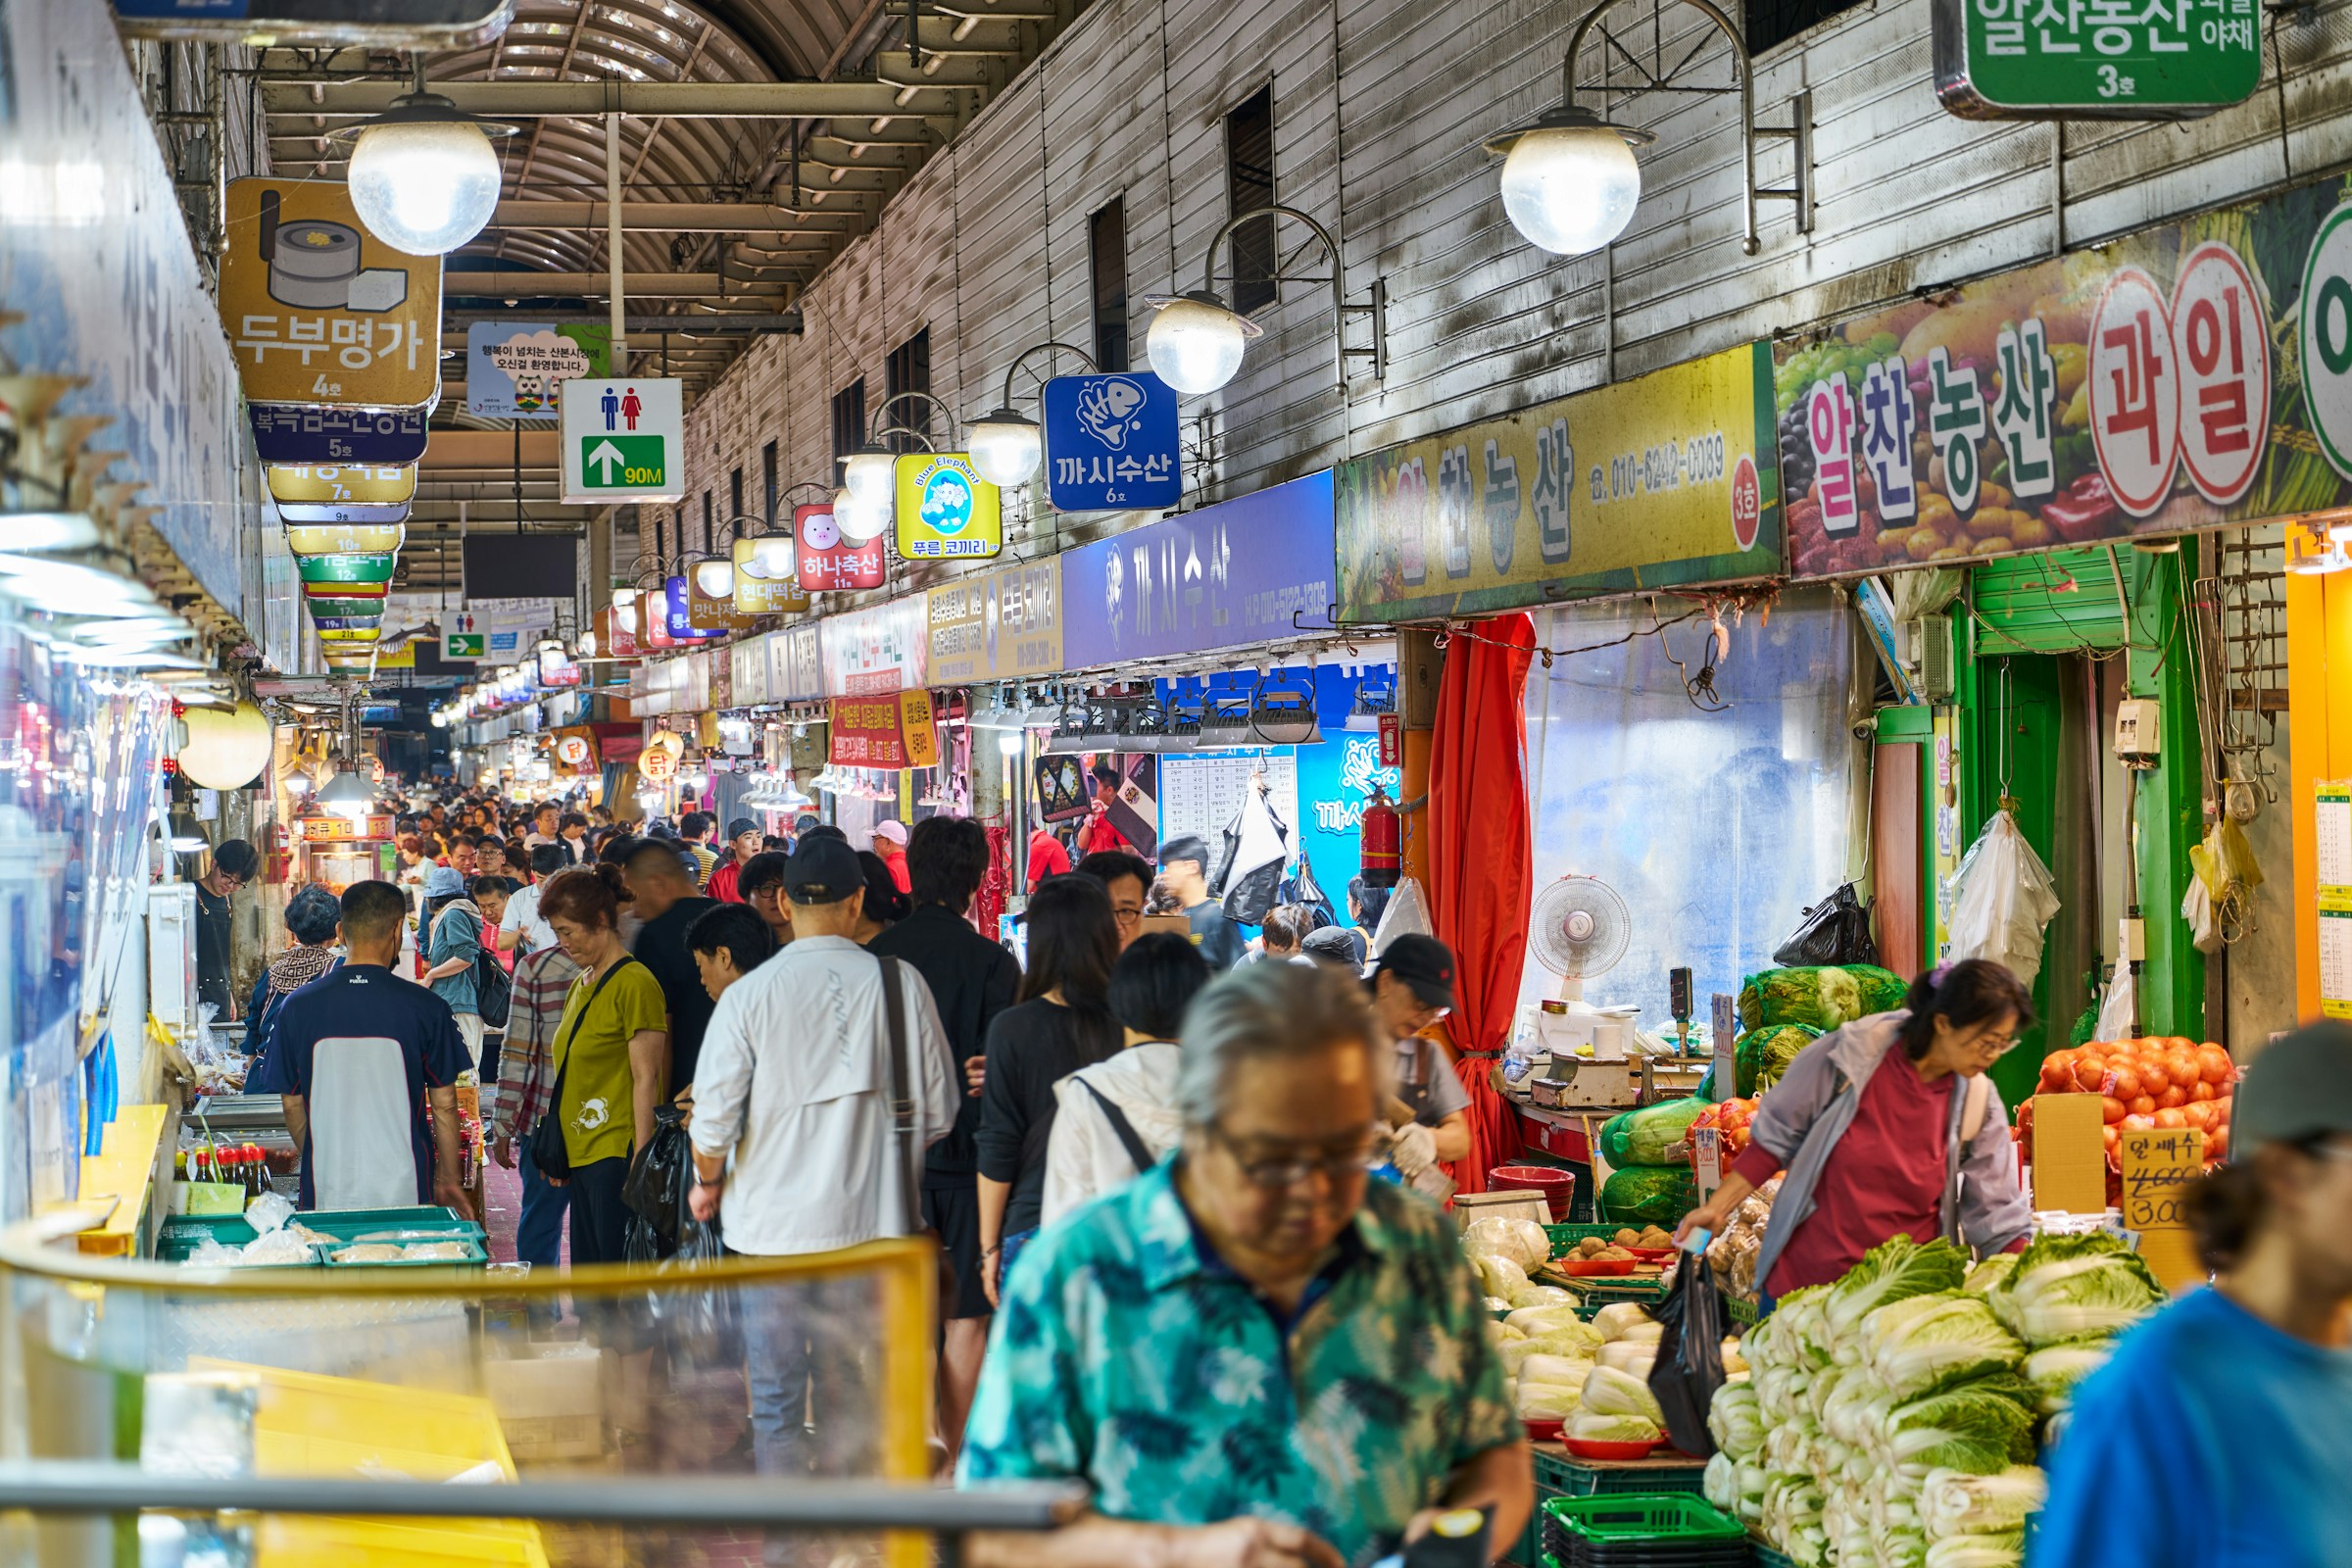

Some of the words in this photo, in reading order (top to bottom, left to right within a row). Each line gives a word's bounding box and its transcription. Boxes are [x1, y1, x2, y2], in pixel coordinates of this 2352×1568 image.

[2200, 19, 2253, 51] 야채
[2096, 64, 2136, 98] 3호
[236, 315, 423, 370] 두부명가
[482, 345, 513, 356] 행복이
[515, 346, 546, 357] 넘치는
[550, 347, 600, 359] 산본시장에
[497, 360, 527, 370] 오신걸
[531, 360, 584, 372] 환영합니다.
[312, 374, 342, 397] 4호
[1811, 321, 2055, 524] 알찬농산
[2102, 286, 2251, 466] 과일
[329, 438, 353, 458] 5호
[624, 467, 662, 484] 90M
[914, 465, 935, 487] Blue
[935, 456, 981, 486] Elephant
[1056, 453, 1173, 485] 까시수산
[1612, 434, 1723, 498] 010-6242-0089
[1736, 483, 1756, 519] 3호
[331, 483, 351, 500] 7호
[1105, 488, 1127, 504] 6호
[335, 513, 350, 521] 9호
[912, 540, 941, 556] 푸른
[945, 539, 987, 555] 코끼리
[804, 552, 879, 577] 하나축산
[740, 582, 804, 603] 현대떡집
[694, 603, 749, 619] 맛나제
[650, 755, 668, 775] 닭
